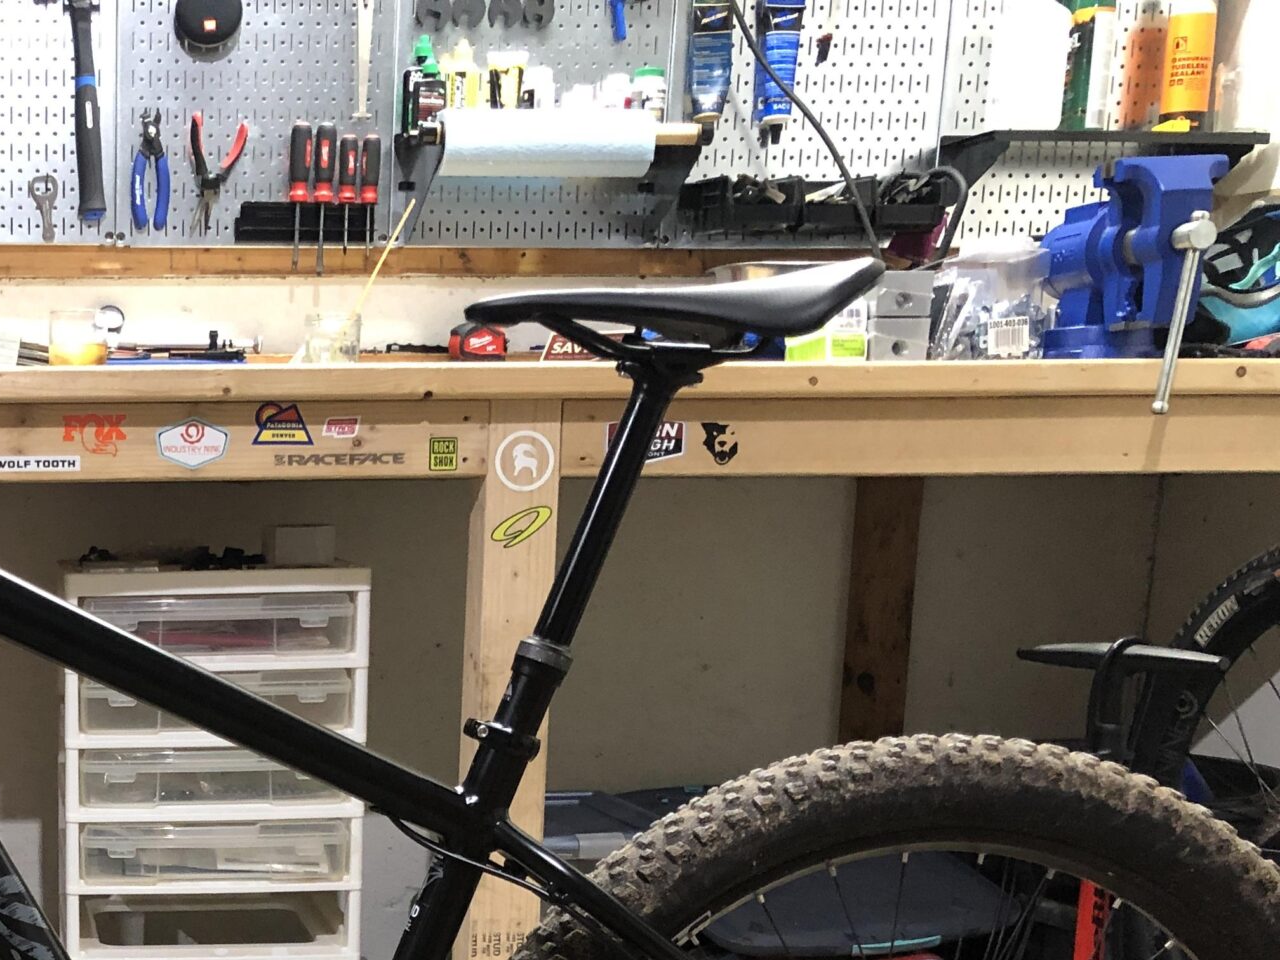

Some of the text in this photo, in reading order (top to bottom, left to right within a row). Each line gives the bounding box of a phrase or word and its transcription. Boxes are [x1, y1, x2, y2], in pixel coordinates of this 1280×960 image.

[550, 342, 588, 354] SAV
[62, 414, 127, 446] FOX
[432, 440, 455, 454] ROCK
[36, 459, 76, 468] TOOTH
[432, 455, 455, 468] SHOX
